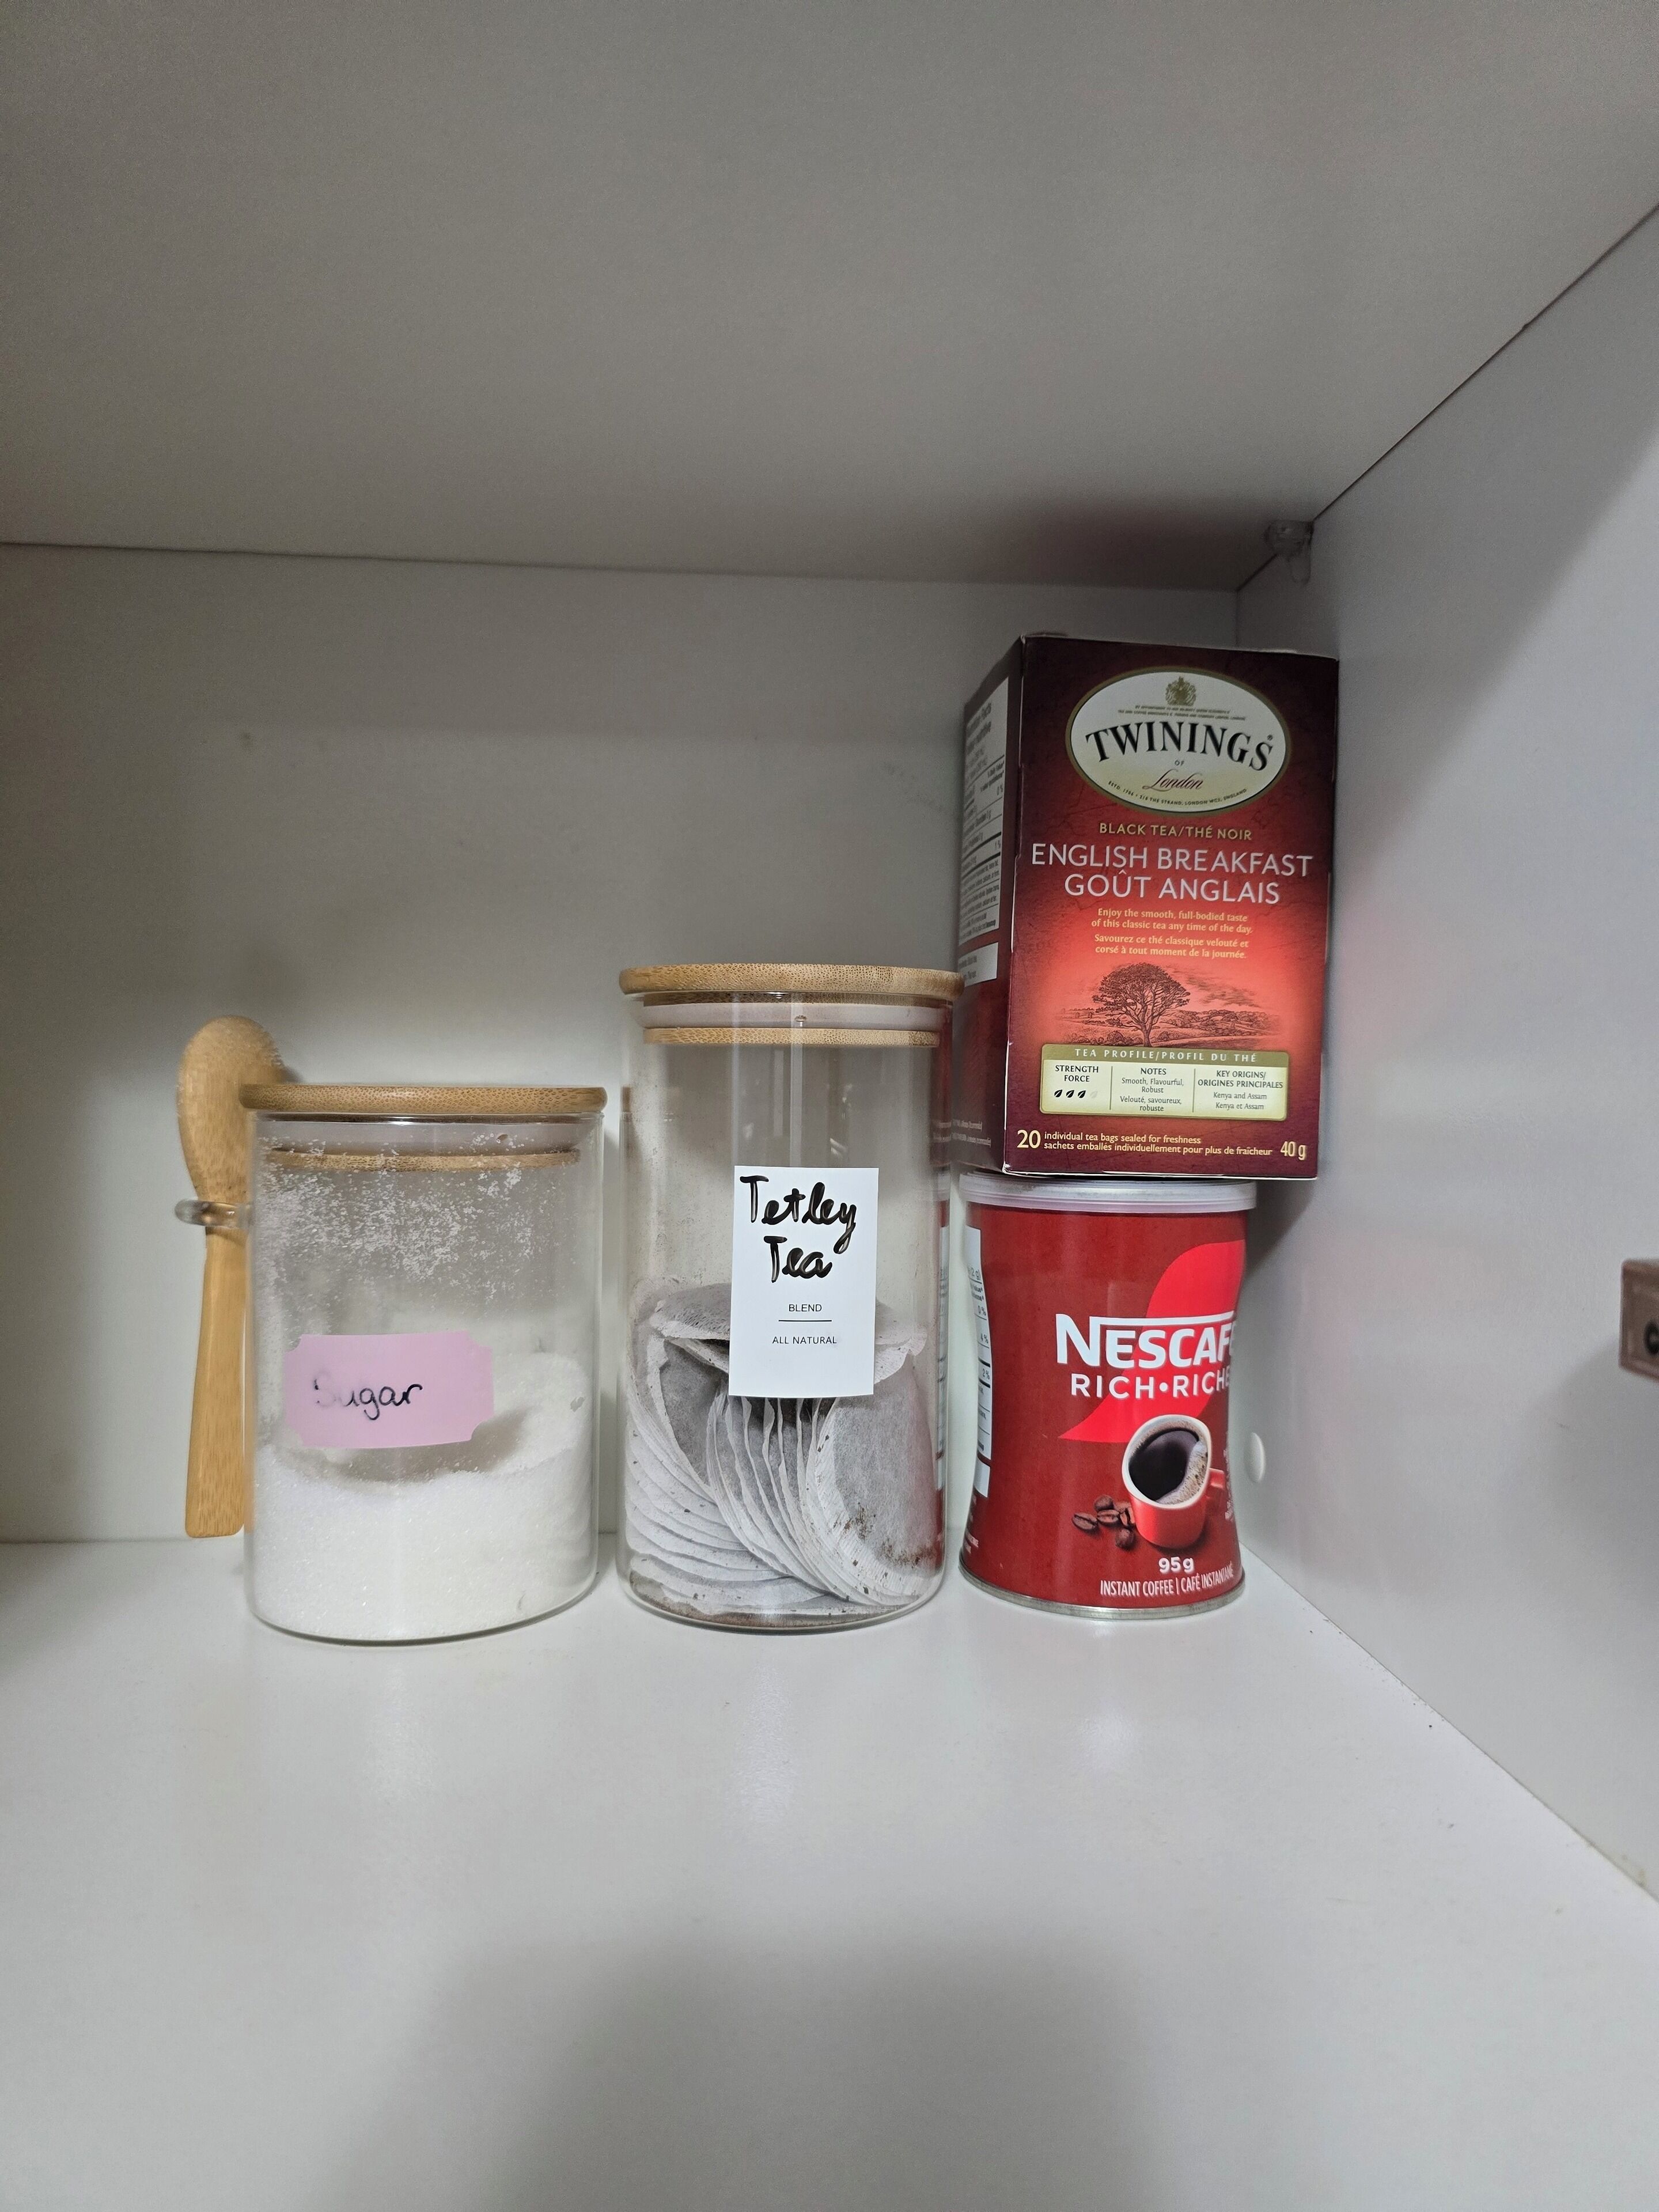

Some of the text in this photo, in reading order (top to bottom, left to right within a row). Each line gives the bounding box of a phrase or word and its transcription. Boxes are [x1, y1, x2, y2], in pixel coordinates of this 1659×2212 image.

[1085, 721, 1273, 771] TWININGS
[1142, 768, 1204, 792] London
[1099, 823, 1252, 841] BLACK TEA/THÉ NOIR
[1032, 843, 1313, 877] ENGLISH BREAKFAST
[1065, 869, 1281, 904] GOÛT ANGLAIS
[1098, 908, 1122, 918] Enjoy
[1124, 908, 1138, 917] the
[1141, 910, 1176, 920] smooth,
[1179, 910, 1224, 921] full-bodied
[1092, 919, 1102, 927] of
[1103, 919, 1120, 927] this
[1122, 920, 1150, 929] classic
[1168, 924, 1184, 932] any
[1186, 923, 1206, 931] time
[1209, 923, 1218, 931] of
[1220, 924, 1234, 932] the
[1094, 934, 1134, 944] Savourez
[1149, 935, 1162, 944] thé
[1165, 937, 1204, 947] classique
[1207, 938, 1238, 948] velouté
[1095, 945, 1119, 953] corsé
[1121, 946, 1126, 954] à
[1150, 948, 1187, 956] moment
[1189, 948, 1199, 957] de
[1202, 949, 1209, 957] la
[1211, 949, 1247, 959] journée.
[1104, 1050, 1204, 1061] PROFILE/PROFIL
[1211, 1053, 1226, 1061] DU
[1234, 1053, 1257, 1062] THÉ
[1055, 1065, 1099, 1073] STRENGTH
[1232, 1071, 1266, 1080] ORIGINS/
[1122, 1077, 1184, 1086] Smooth, Flavourful,
[1213, 1092, 1232, 1100] Kenya
[1215, 1102, 1234, 1111] Kenya
[1017, 1129, 1041, 1149] 20
[1044, 1131, 1083, 1140] individual
[1101, 1133, 1118, 1143] bags
[1121, 1134, 1146, 1142] sealed
[1149, 1134, 1161, 1143] for
[1163, 1135, 1201, 1143] freshness
[1044, 1141, 1074, 1150] sachets
[1077, 1142, 1112, 1150] emballés
[1114, 1143, 1181, 1153] individuellement
[1205, 1146, 1222, 1156] plus
[1224, 1146, 1234, 1155] de
[1236, 1146, 1272, 1156] fraîcheur
[1280, 1141, 1295, 1157] 40
[740, 1175, 857, 1255] Tetley
[763, 1236, 833, 1283] Tea
[789, 1304, 823, 1312] BLEND
[772, 1336, 837, 1345] ALL NATURAL
[1100, 1560, 1234, 1596] INSTANT COFFEE CAFÉ INSTANTANÉ
